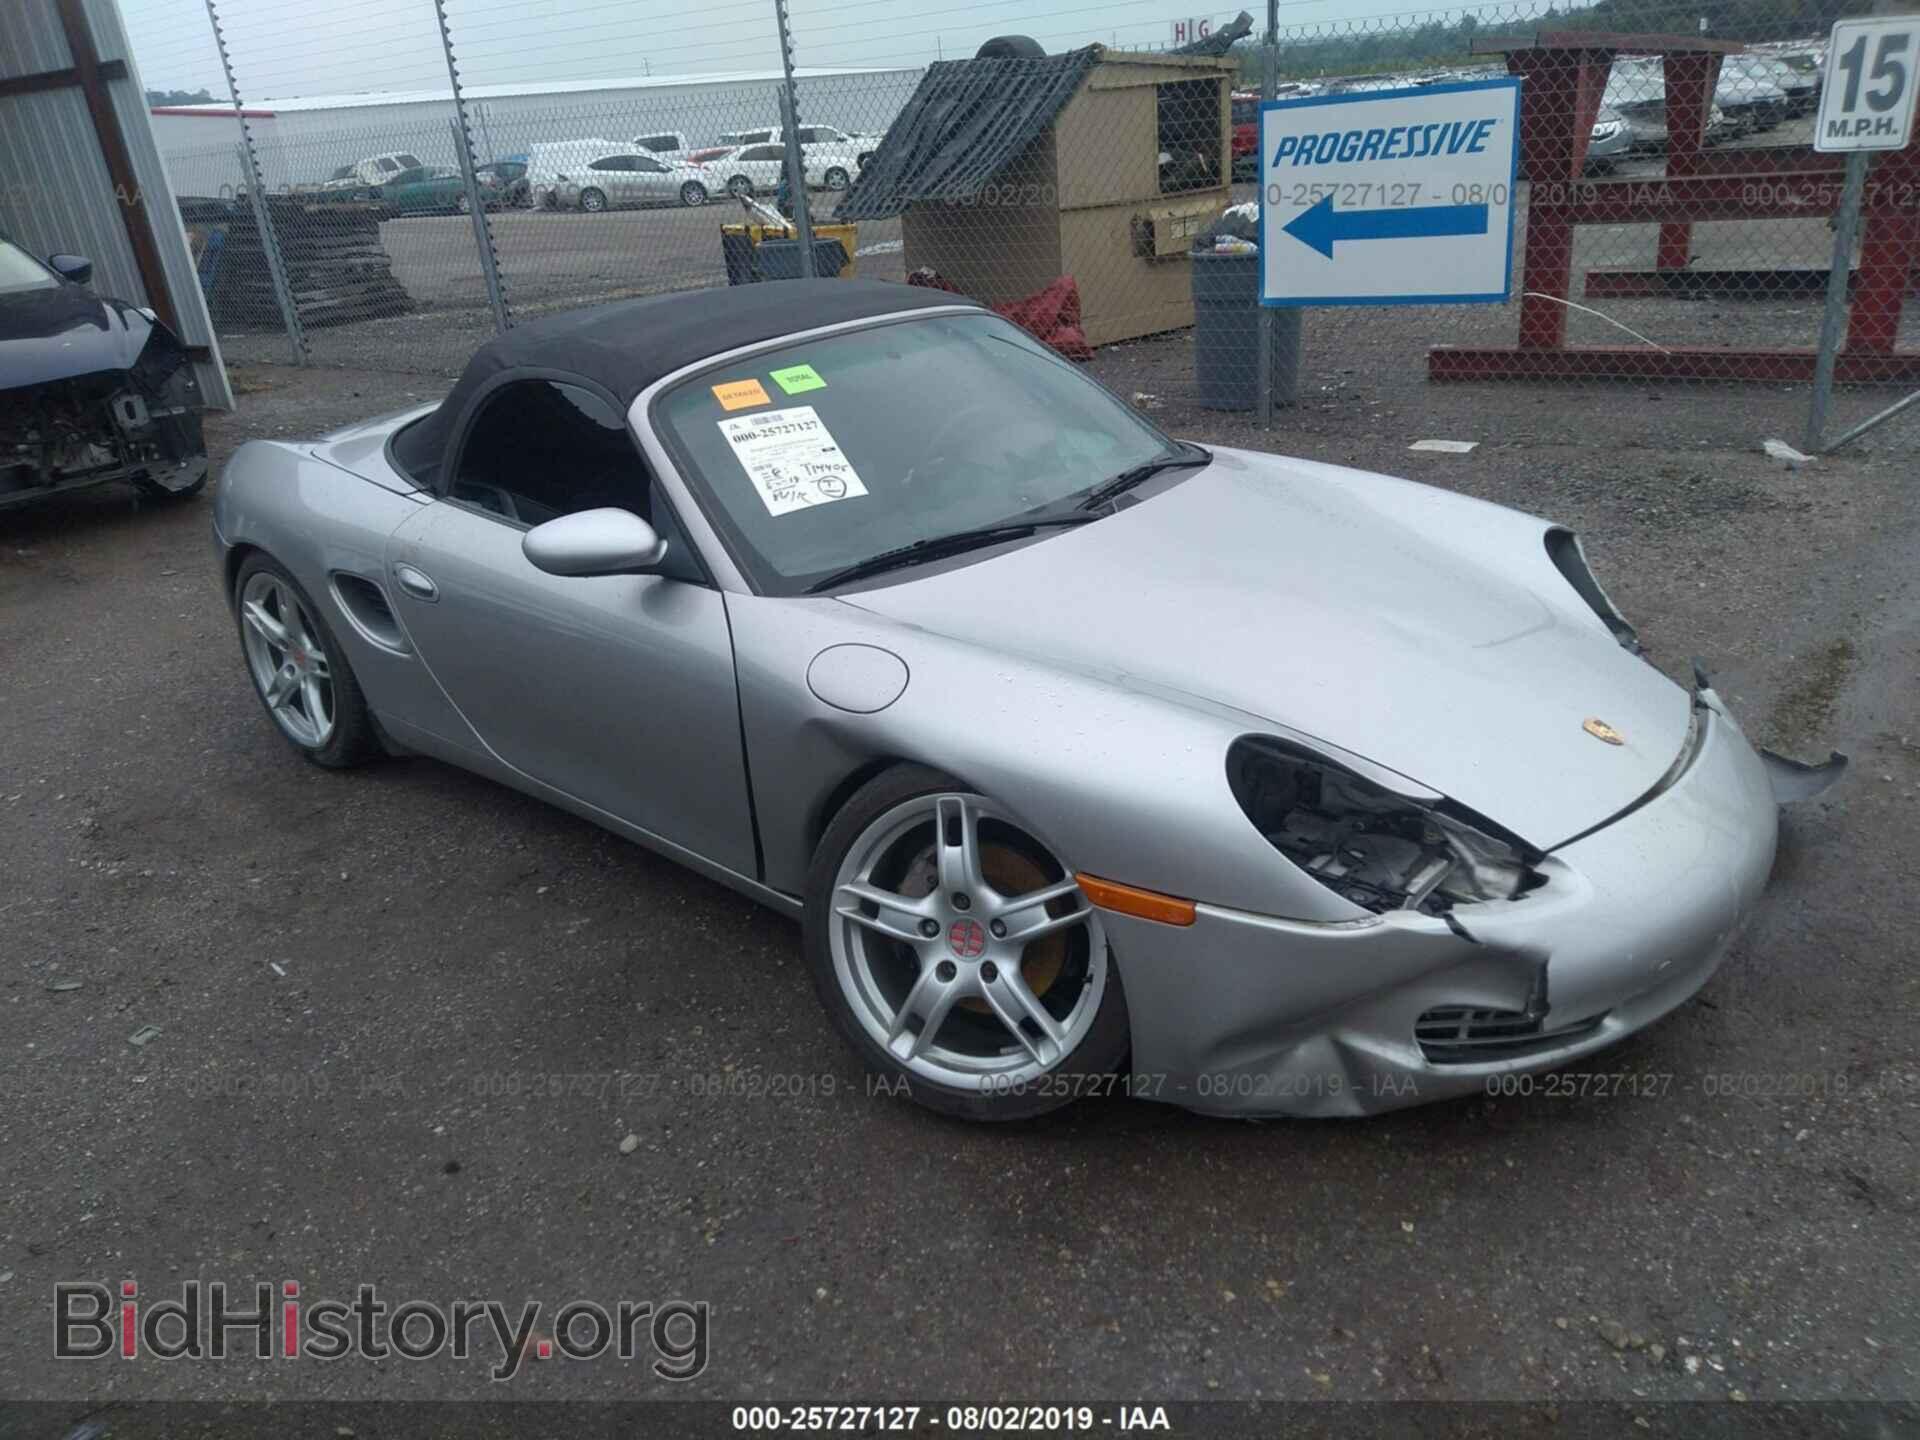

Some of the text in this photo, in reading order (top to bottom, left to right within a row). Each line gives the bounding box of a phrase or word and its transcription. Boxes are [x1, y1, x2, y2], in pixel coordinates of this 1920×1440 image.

[1838, 32, 1911, 113] 15
[1272, 118, 1498, 168] PROGRESSIVE
[1826, 117, 1898, 138] M.P.H.
[732, 420, 818, 443] 000-25727127
